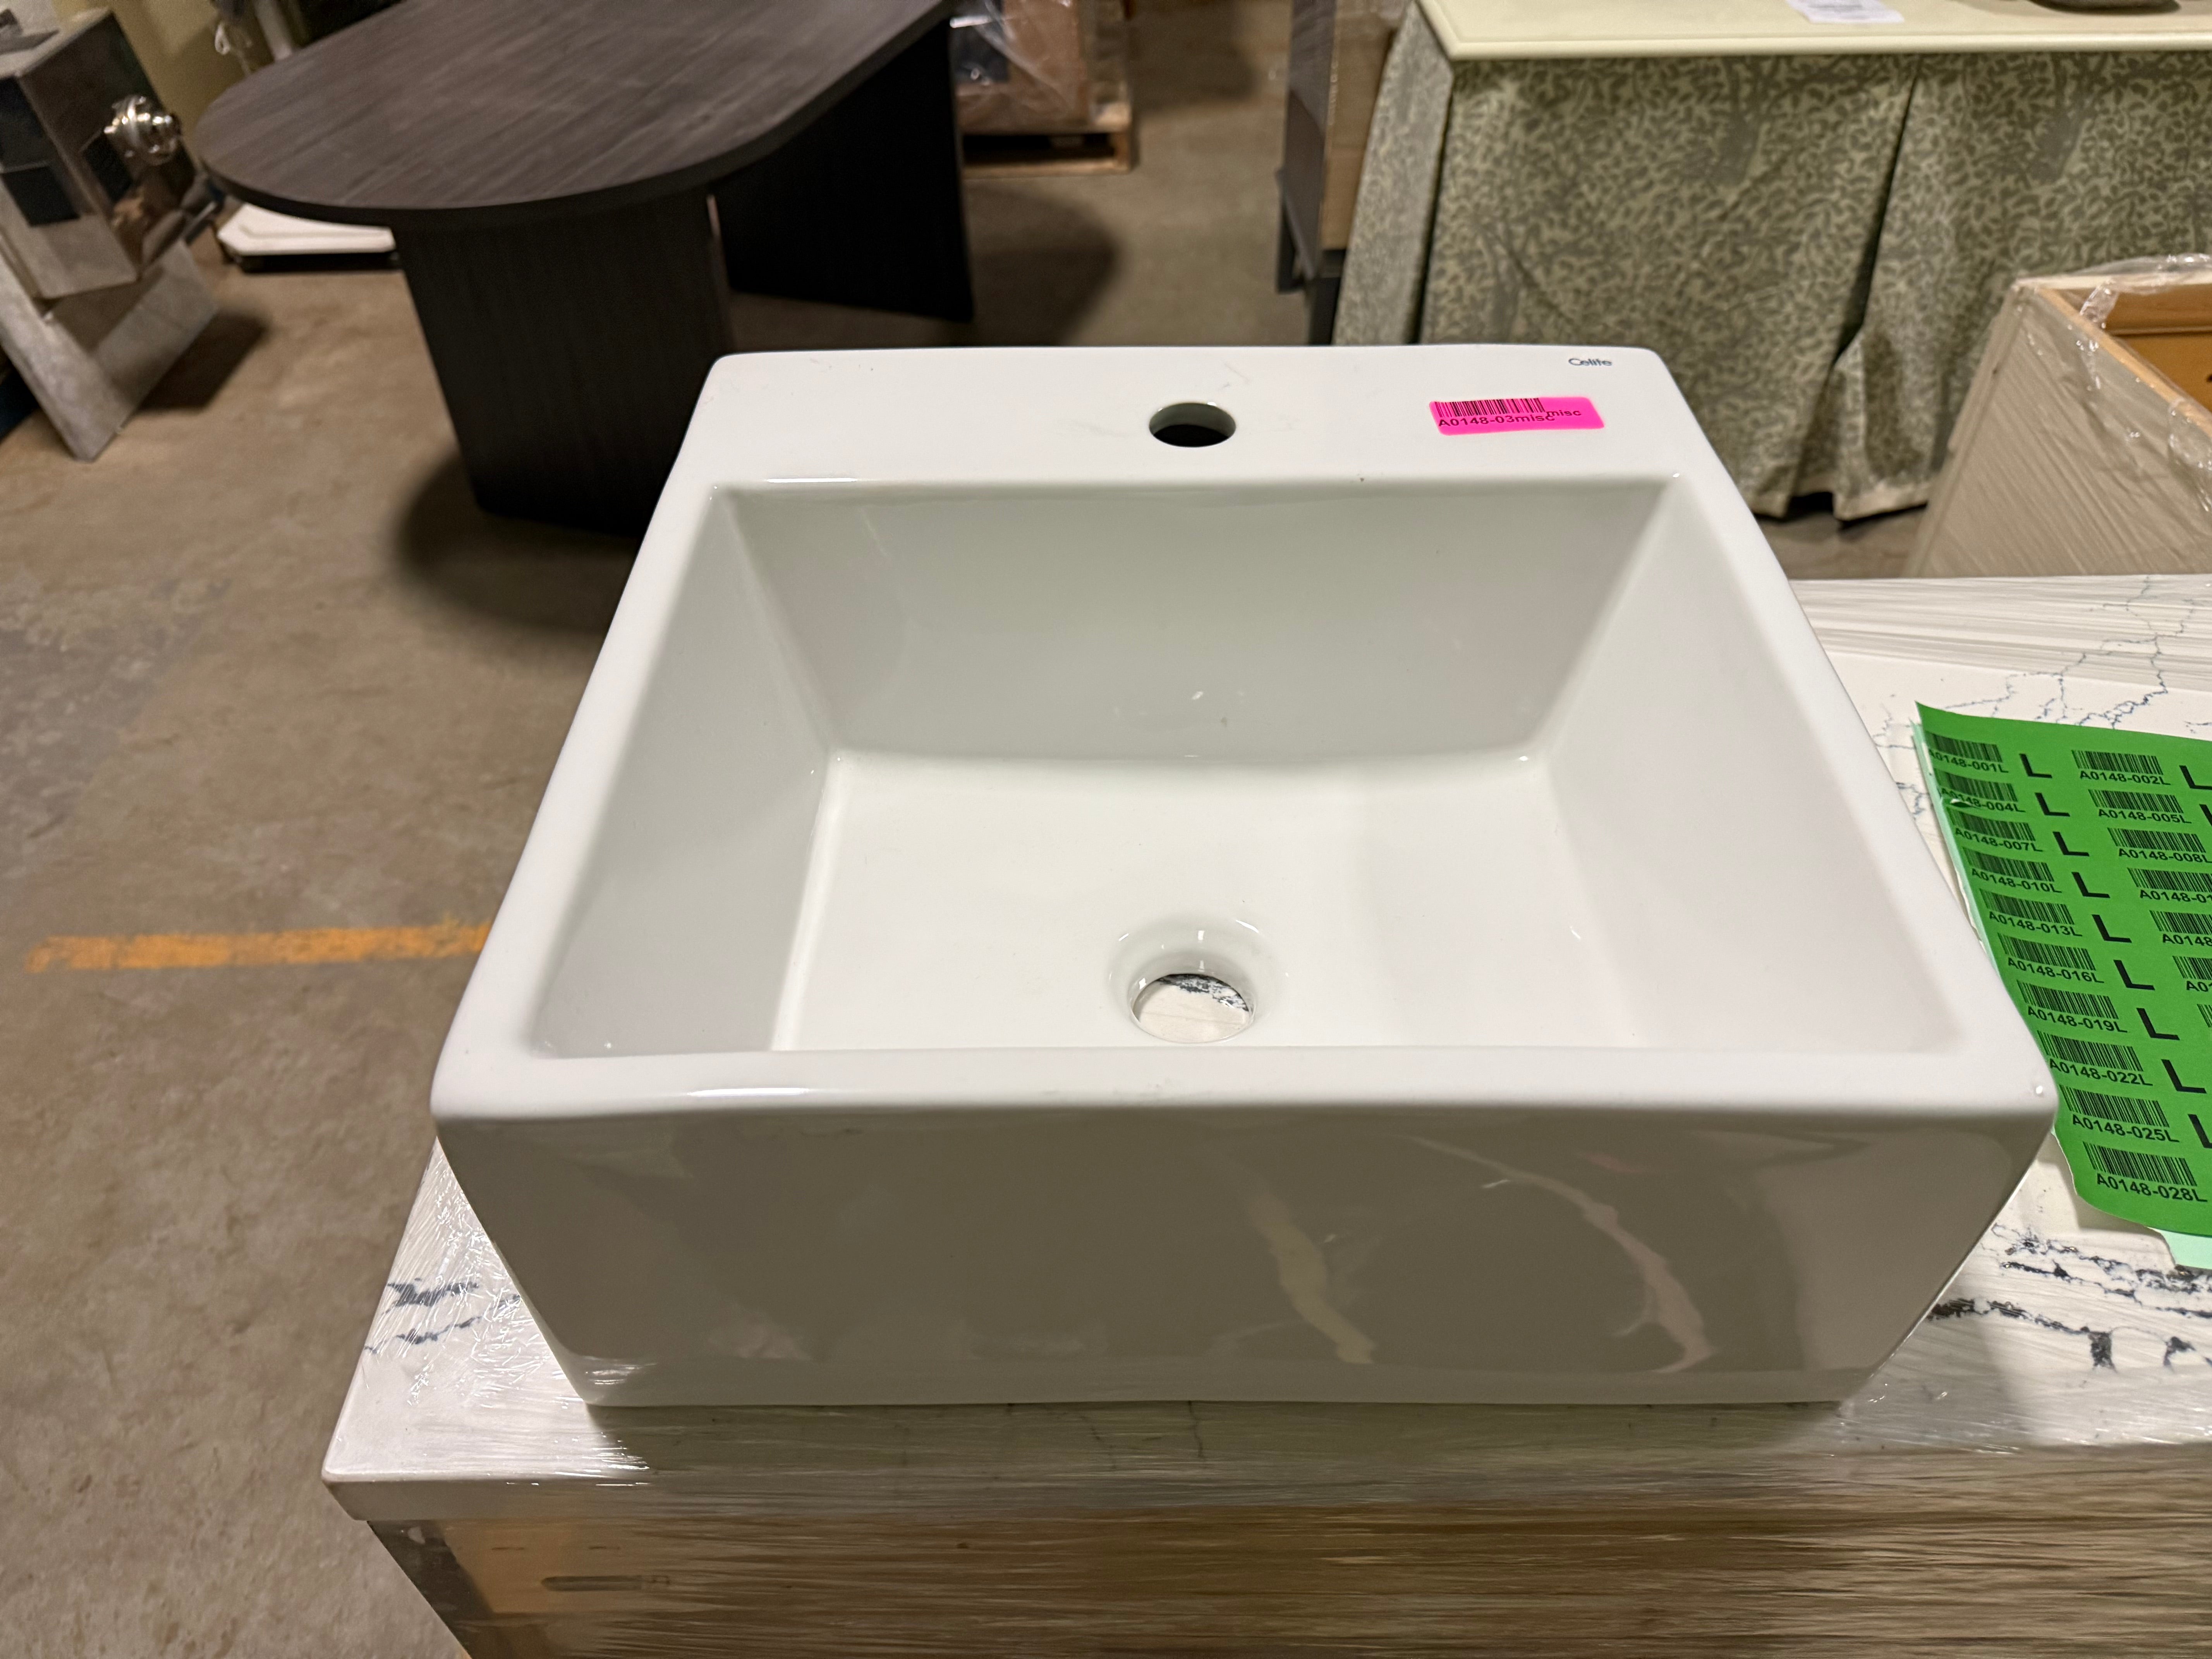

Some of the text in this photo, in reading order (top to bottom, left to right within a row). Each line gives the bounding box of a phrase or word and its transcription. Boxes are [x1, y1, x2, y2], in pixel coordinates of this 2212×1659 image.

[1568, 358, 1613, 366] Celite
[1438, 414, 1555, 427] A0148-03misc
[2019, 753, 2052, 778] L
[2080, 770, 2171, 786] A0148-002L
[2035, 792, 2071, 817] L
[2098, 808, 2192, 824] A0148-005L
[1955, 828, 2043, 852] A0148-007L
[2052, 831, 2090, 857] L
[2118, 848, 2212, 864] A0148-008L
[1972, 868, 2063, 893] A0148-010L
[2071, 871, 2111, 899] L
[1989, 911, 2083, 937] A0148-013L
[2091, 914, 2132, 944] L
[2008, 957, 2105, 984] A0148-016L
[2113, 959, 2155, 991] L
[2028, 1006, 2128, 1033] A0148-019L
[2136, 1007, 2180, 1041] L
[2049, 1058, 2154, 1086] A0148-022L
[2160, 1059, 2207, 1094] L
[2072, 1114, 2180, 1143] A0148-025L
[2097, 1173, 2208, 1202] A0148-028L
